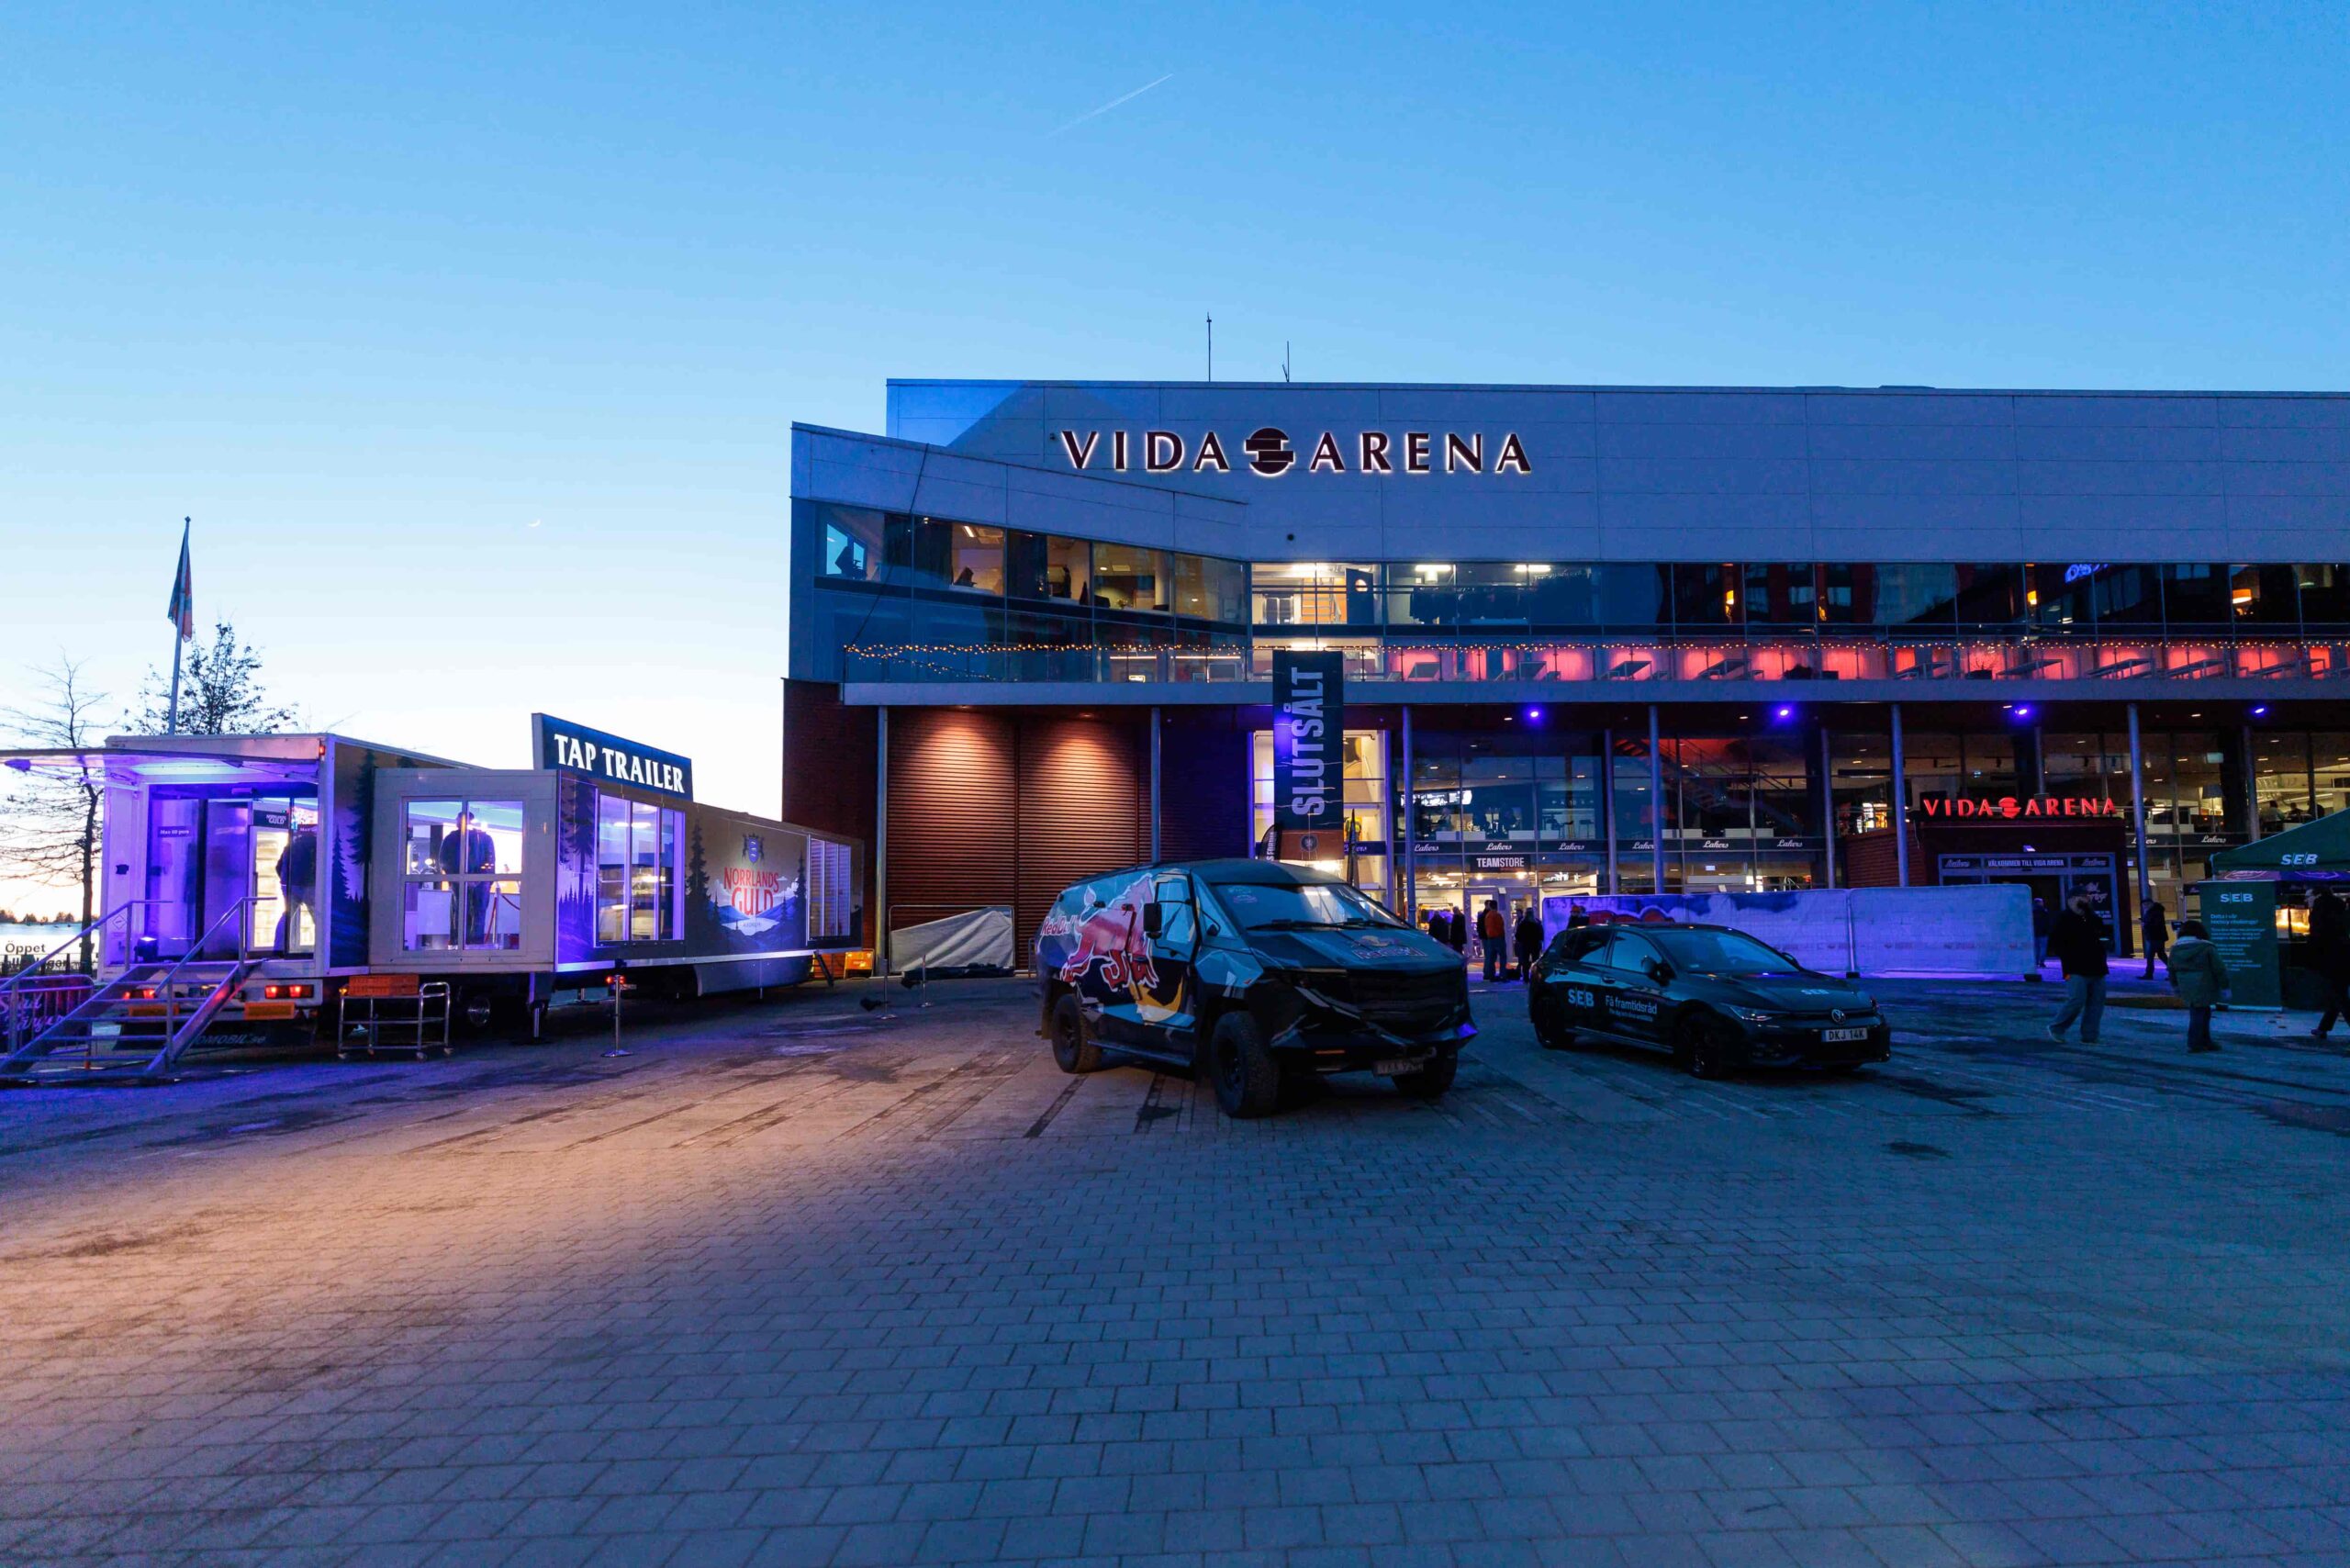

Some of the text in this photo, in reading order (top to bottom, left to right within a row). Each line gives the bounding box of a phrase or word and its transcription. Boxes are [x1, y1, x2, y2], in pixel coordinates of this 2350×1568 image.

[1061, 430, 1531, 473] VIDA ARENA
[1282, 667, 1325, 815] SLUTSÅLT
[554, 734, 685, 794] TAP TRAILER
[1923, 798, 2118, 817] VIDA ARENA
[1703, 840, 1729, 848] Lakers
[1777, 839, 1803, 847] Lakers
[2201, 834, 2226, 844] Lakers
[1414, 844, 1439, 852] Lakers
[1486, 842, 1512, 850] Lakers
[1559, 842, 1584, 850] Lakers
[1632, 841, 1654, 849] Laker
[1476, 857, 1525, 868] TEAMSTORE
[2281, 854, 2318, 866] SEB
[723, 867, 779, 893] NORRLANDS
[732, 887, 773, 915] GULD
[2220, 893, 2254, 902] SEB
[6, 940, 46, 955] Öppet
[1568, 989, 1595, 1007] SEB
[1606, 995, 1658, 1014] Få framtidsråd
[1829, 1031, 1846, 1040] DKJ
